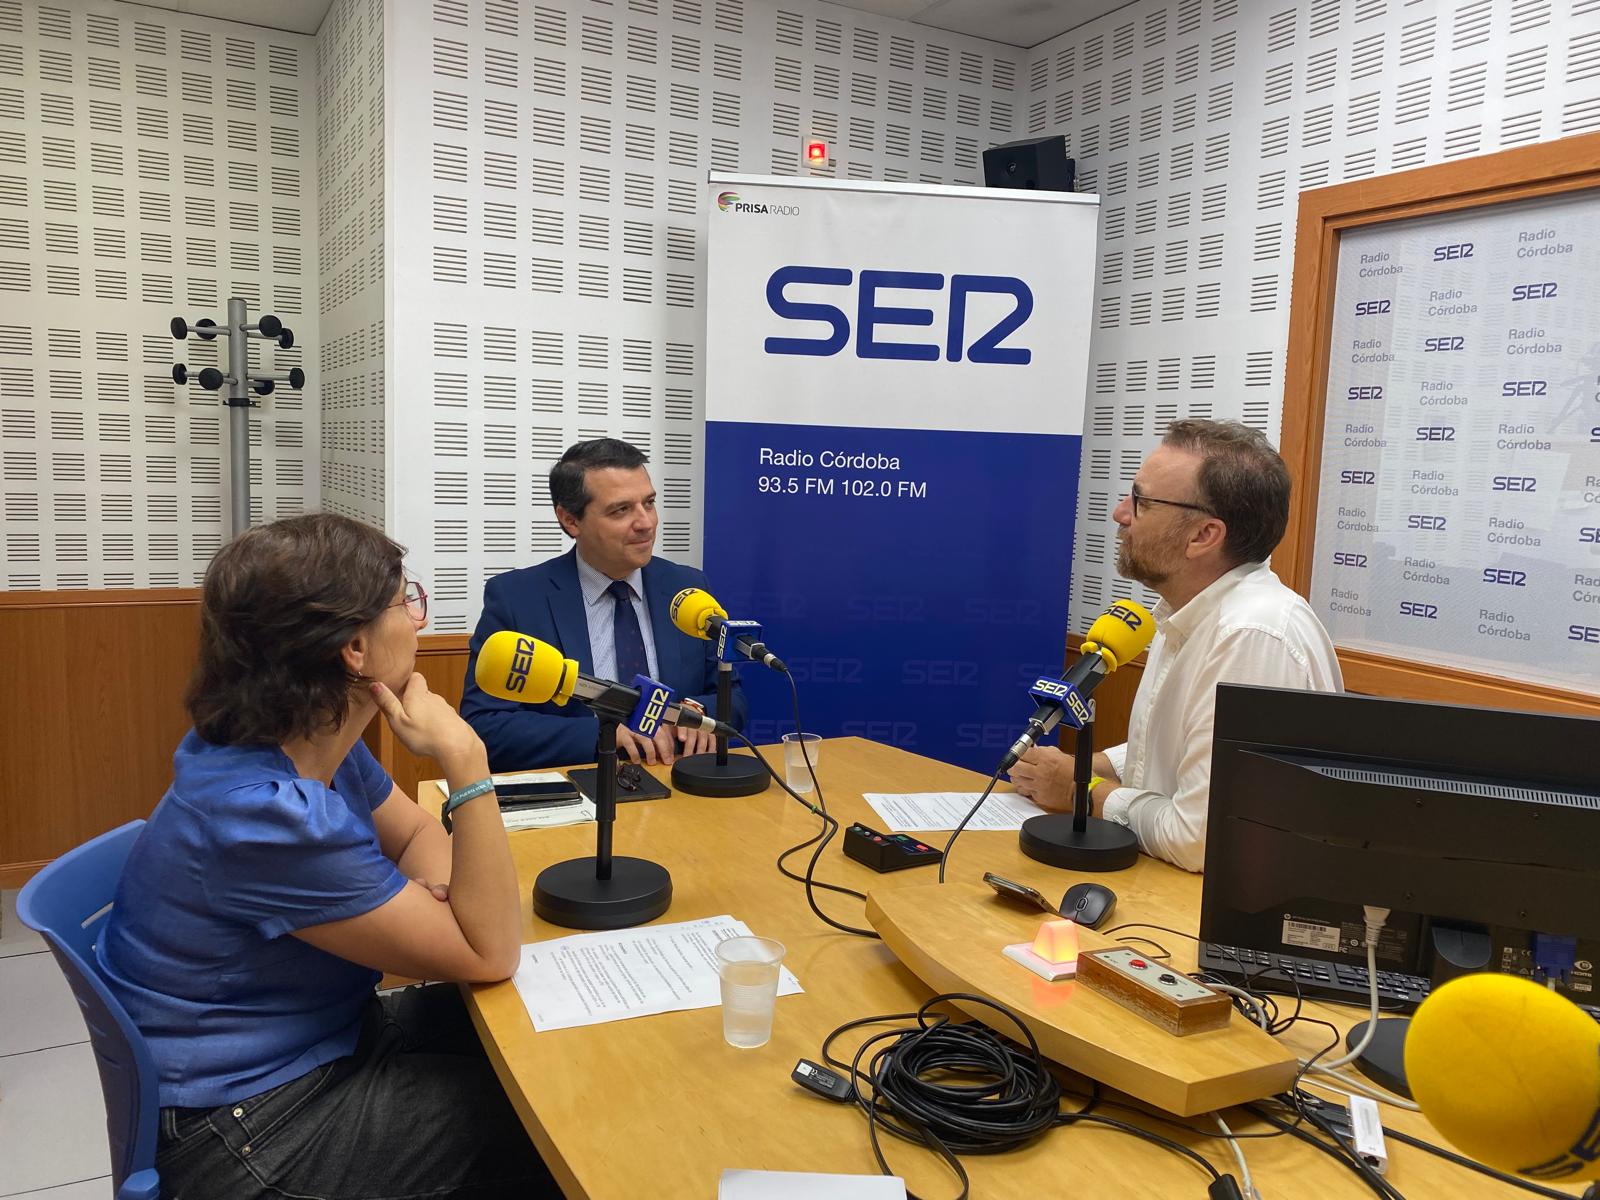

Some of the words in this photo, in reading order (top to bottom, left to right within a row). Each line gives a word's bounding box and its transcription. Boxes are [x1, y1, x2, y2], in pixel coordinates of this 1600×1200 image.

[735, 203, 768, 214] PRISA
[769, 204, 800, 216] RADIO
[1518, 229, 1556, 243] Radio
[1433, 243, 1474, 261] SER
[1517, 243, 1573, 258] Córdoba
[1360, 252, 1389, 264] Radio
[1359, 264, 1403, 278] Córdoba
[1430, 290, 1462, 302] Radio
[1512, 283, 1557, 301] SER
[1355, 300, 1390, 316] SER
[1428, 303, 1477, 316] Córdoba
[764, 265, 1034, 366] SER
[1508, 329, 1545, 340] Radio
[1353, 340, 1381, 349] Radio
[1424, 337, 1464, 351] SER
[1507, 341, 1562, 355] Córdoba
[1352, 353, 1395, 363] Córdoba
[1348, 386, 1383, 400] SER
[1421, 382, 1453, 390] Radio
[1502, 381, 1547, 396] SER
[1420, 395, 1468, 405] Córdoba
[1345, 424, 1374, 434] Radio
[1416, 427, 1455, 441] SER
[1498, 424, 1534, 434] Radio
[1344, 437, 1387, 447] Córdoba
[1497, 440, 1551, 450] Córdoba
[759, 447, 814, 467] Radio
[819, 450, 901, 471] Córdoba
[1341, 471, 1375, 484] SER
[1413, 470, 1444, 480] Radio
[757, 476, 799, 494] 93.5
[805, 478, 834, 495] FM
[841, 479, 892, 497] 102.0
[897, 481, 927, 498] FM
[1411, 485, 1458, 496] Córdoba
[1492, 477, 1536, 492] SER
[1338, 508, 1366, 517] Radio
[1337, 521, 1379, 532] Córdoba
[1408, 515, 1446, 530] SER
[1489, 518, 1524, 529] Radio
[1487, 533, 1541, 546] Córdoba
[1334, 553, 1367, 567] SER
[1404, 557, 1435, 569] Radio
[1403, 571, 1449, 585] Córdoba
[1483, 568, 1526, 586] SER
[1331, 588, 1359, 600] Radio
[1330, 602, 1371, 616] Córdoba
[1400, 601, 1437, 619] SER
[1479, 609, 1514, 623] Radio
[1478, 624, 1530, 641] Córdoba
[1568, 625, 1600, 643] SE
[717, 624, 727, 660] SER
[506, 637, 535, 693] SER
[901, 659, 978, 686] SER
[1032, 679, 1069, 697] SER
[639, 688, 669, 734] SER
[1066, 691, 1090, 726] SER
